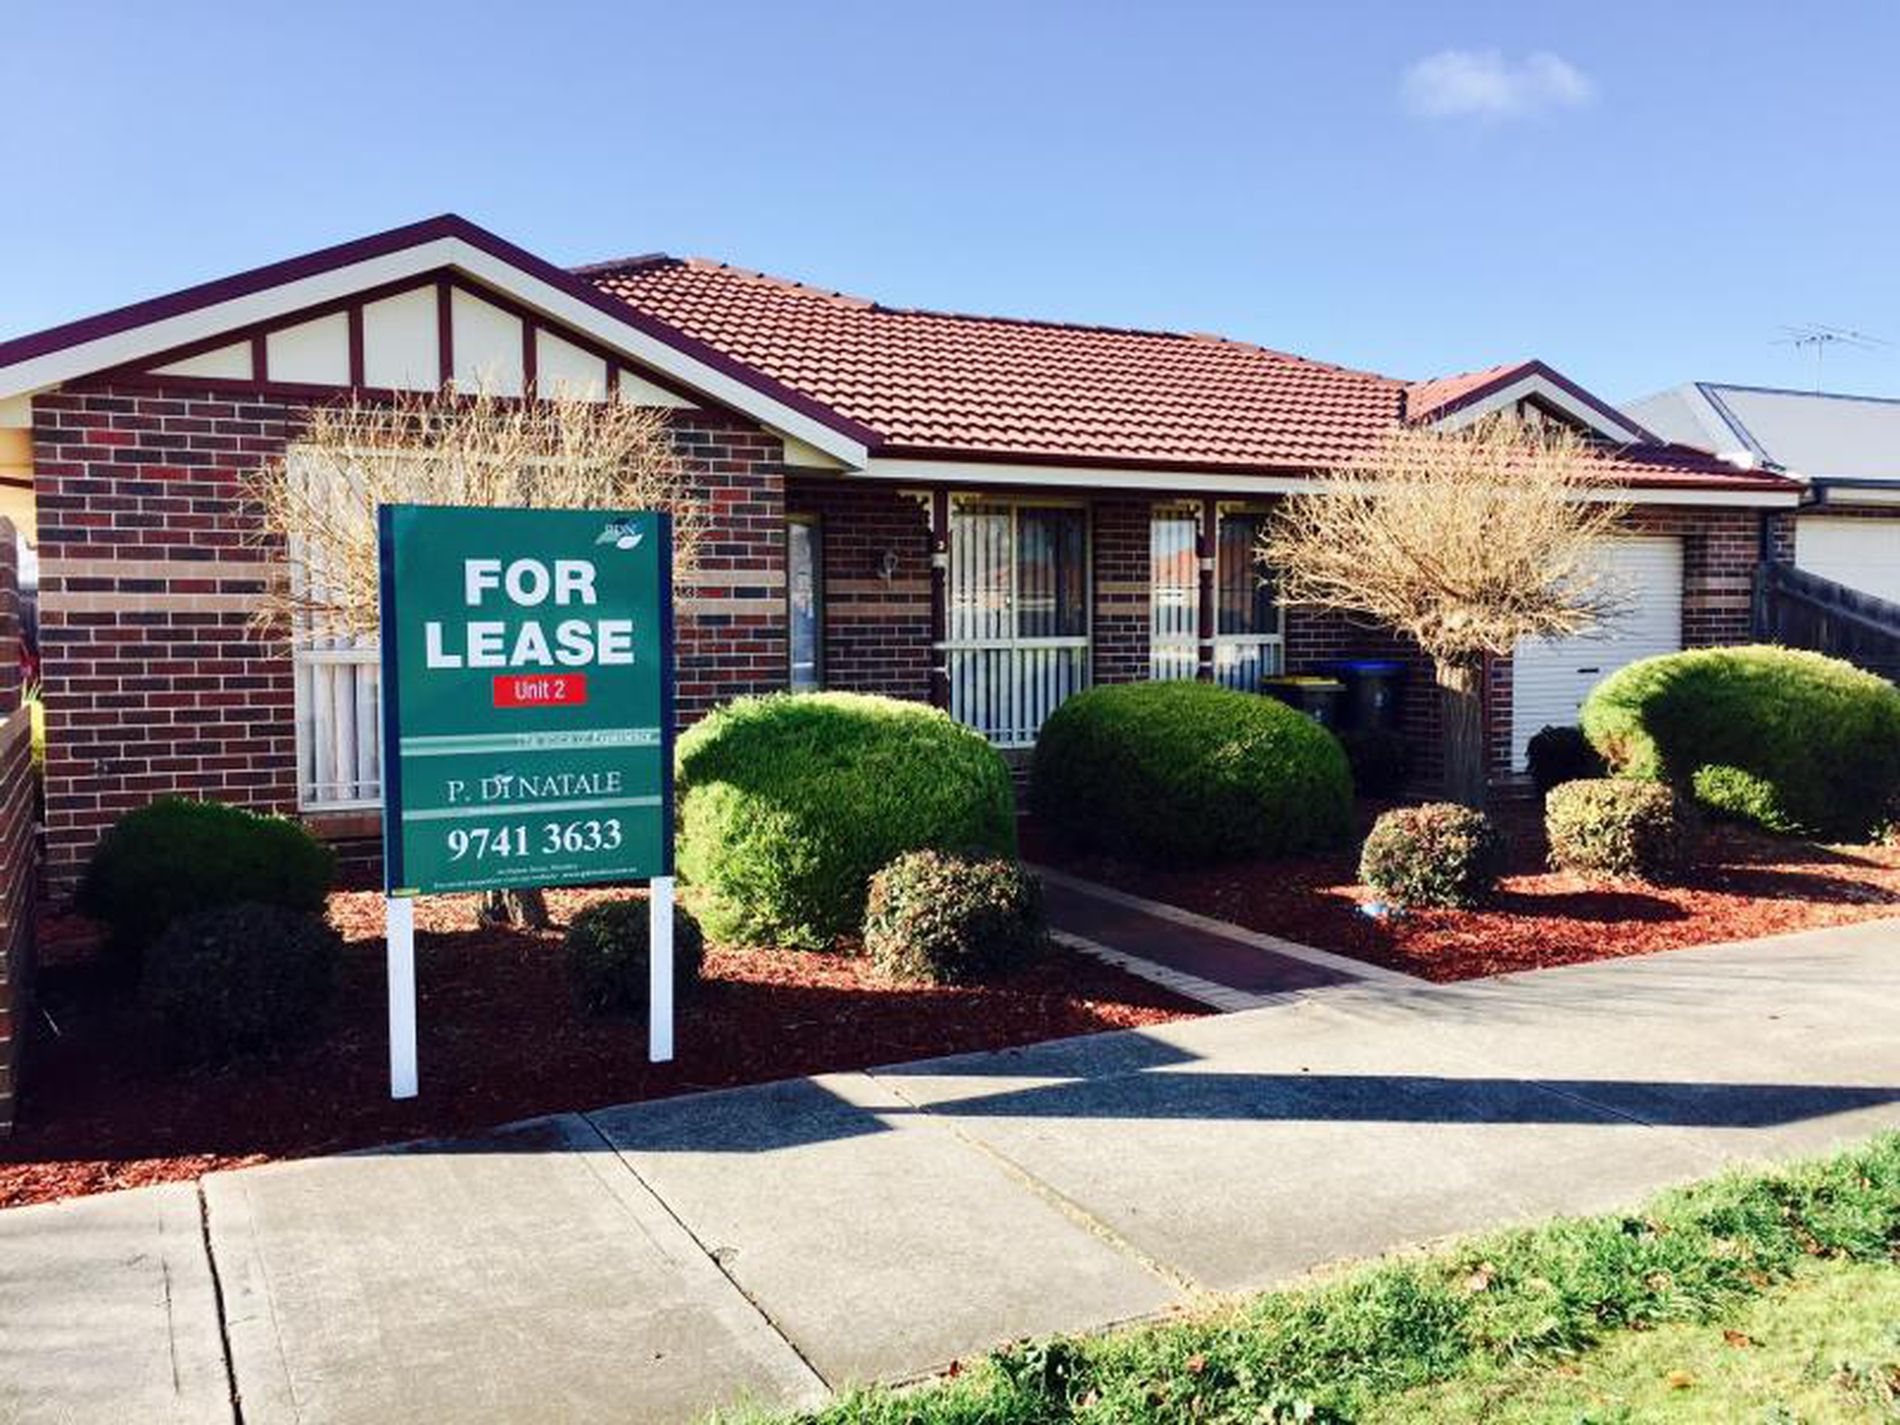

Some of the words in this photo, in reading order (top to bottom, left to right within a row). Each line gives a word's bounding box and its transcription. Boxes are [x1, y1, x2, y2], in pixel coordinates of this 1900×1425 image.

[464, 558, 598, 607] FOR
[424, 619, 636, 669] LEASE
[514, 680, 551, 701] Unit
[554, 680, 567, 699] 2
[446, 780, 472, 802] P.
[447, 825, 530, 862] 9741
[542, 818, 622, 855] 3633
